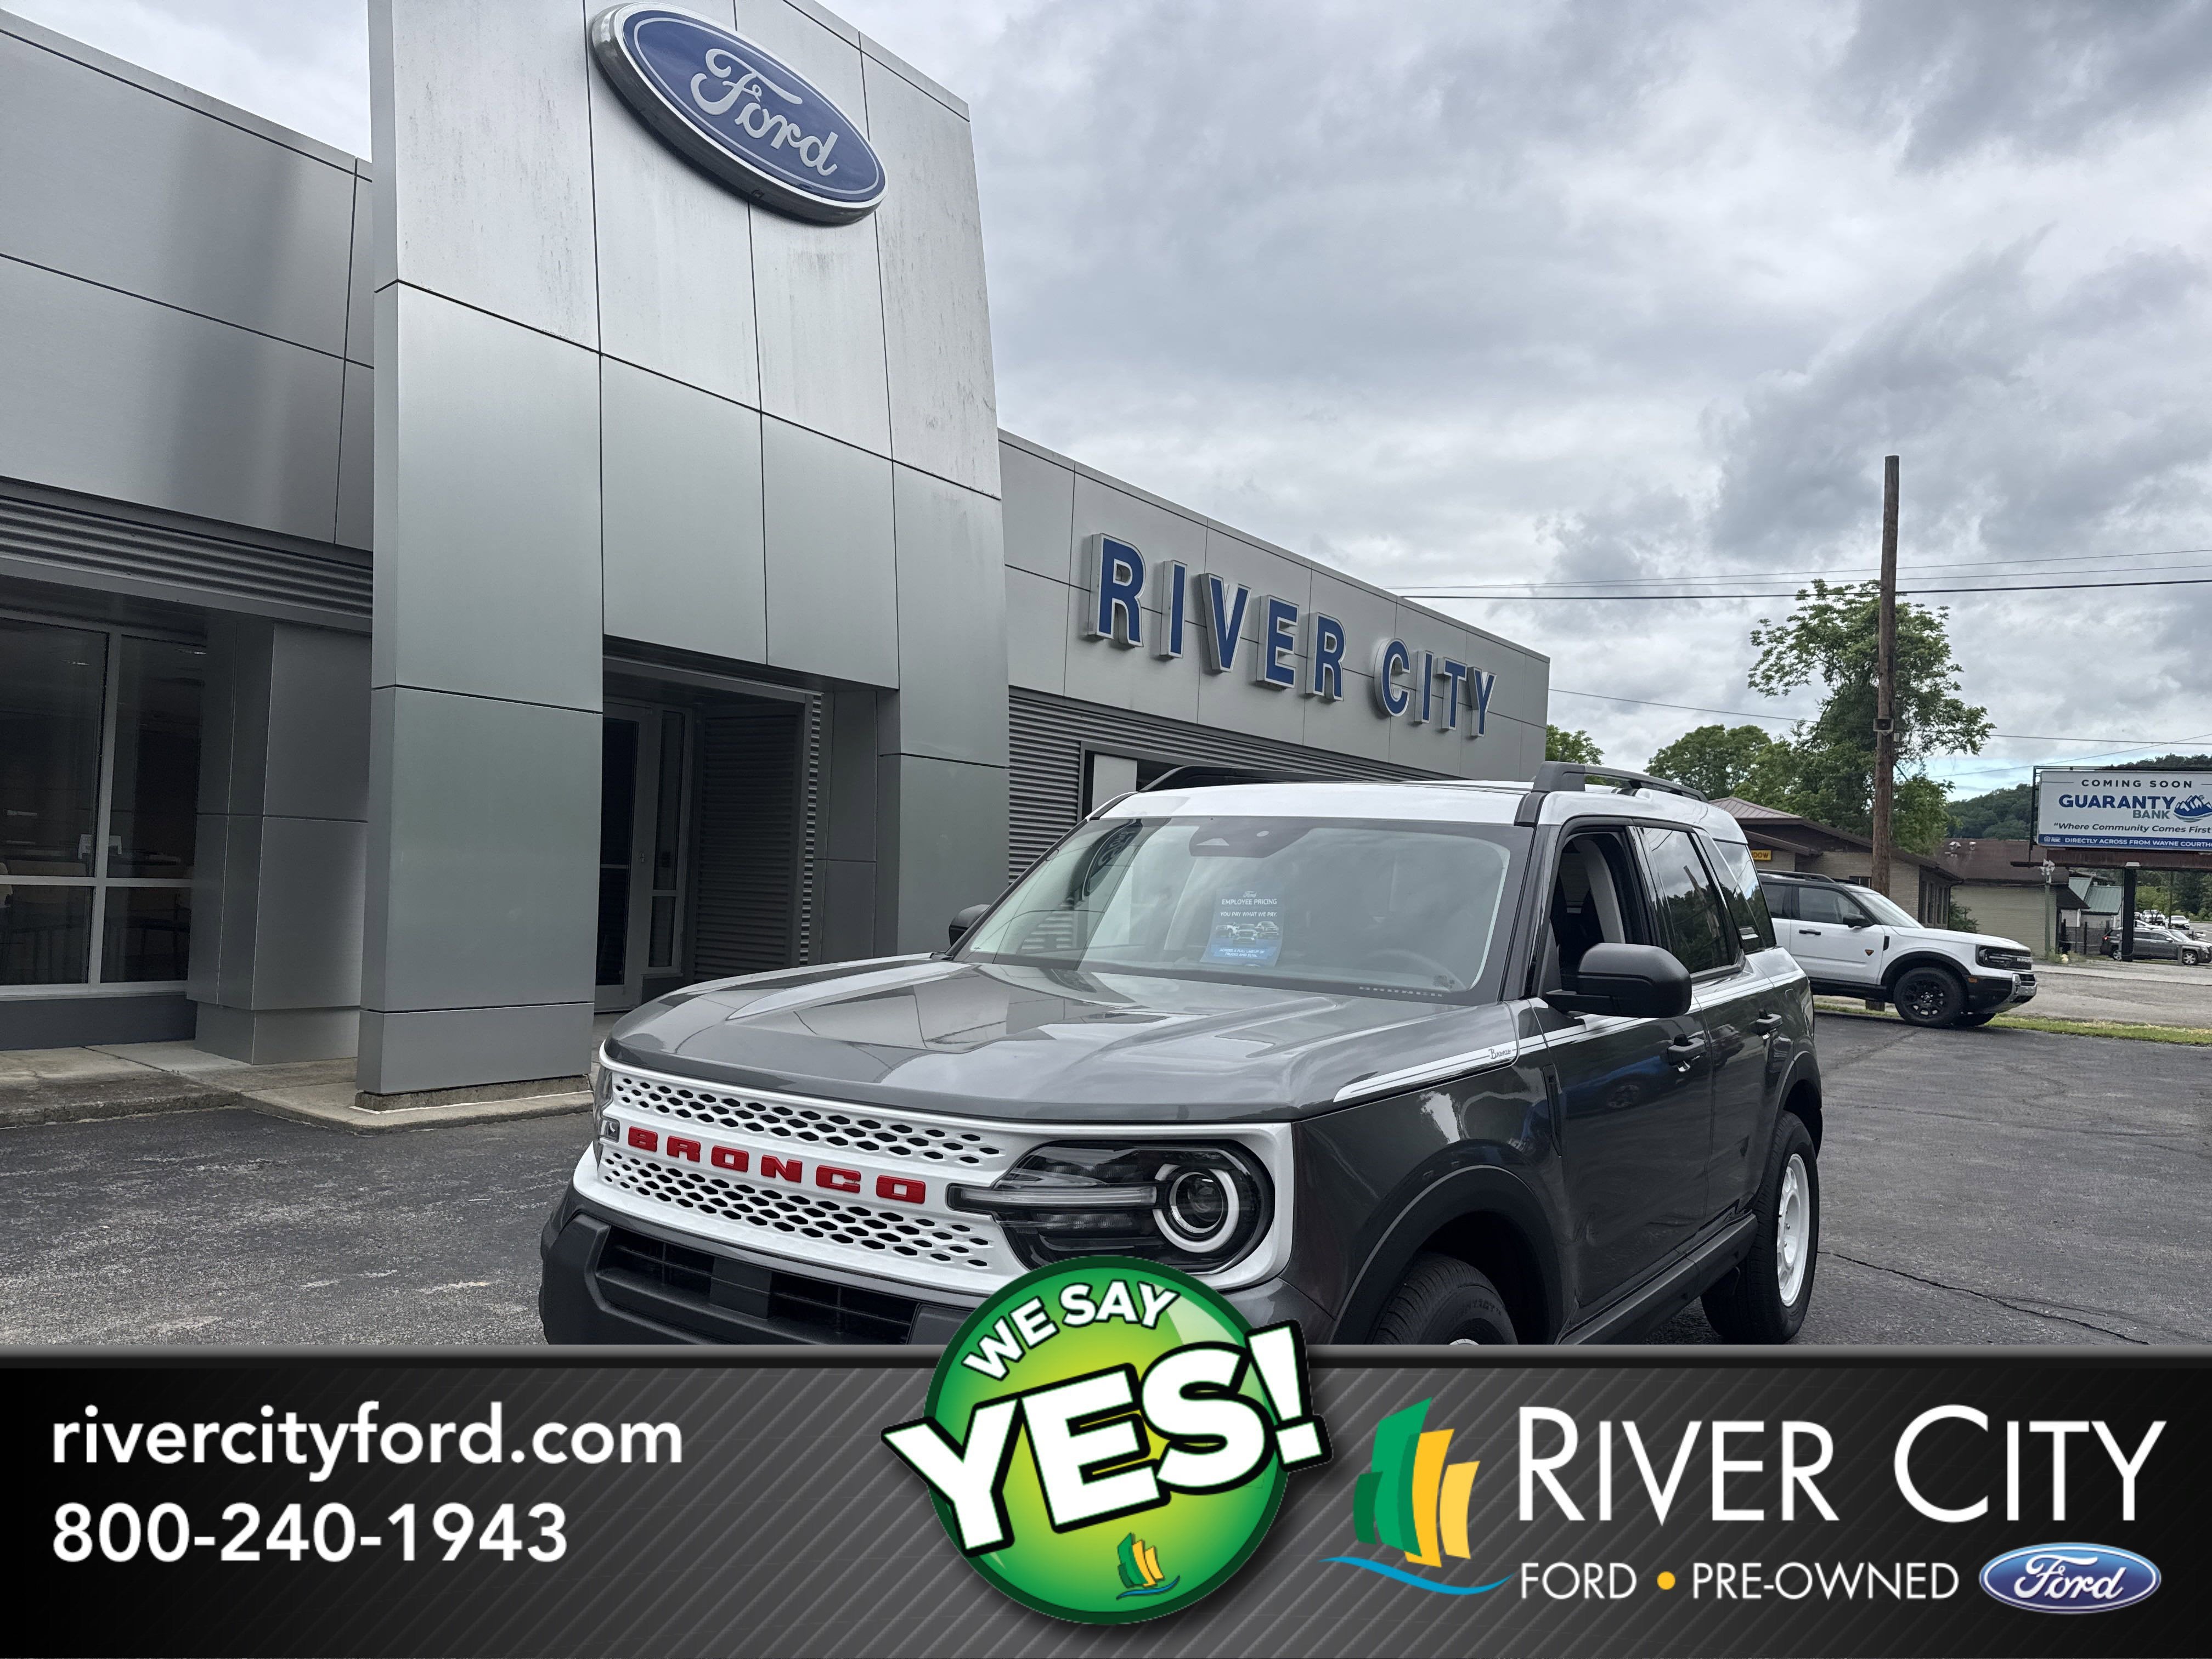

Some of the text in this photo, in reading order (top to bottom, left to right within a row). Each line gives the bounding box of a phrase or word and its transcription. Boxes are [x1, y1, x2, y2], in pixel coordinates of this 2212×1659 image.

[691, 48, 838, 176] Ford
[1088, 533, 1497, 737] RIVER CITY
[2081, 779, 2192, 788] COMING SOON
[2058, 794, 2176, 810] GUARANTY
[2132, 809, 2170, 820] BANK
[2092, 823, 2150, 833] Community
[1488, 1048, 1511, 1059] Bronco
[628, 1125, 926, 1204] BRONCO
